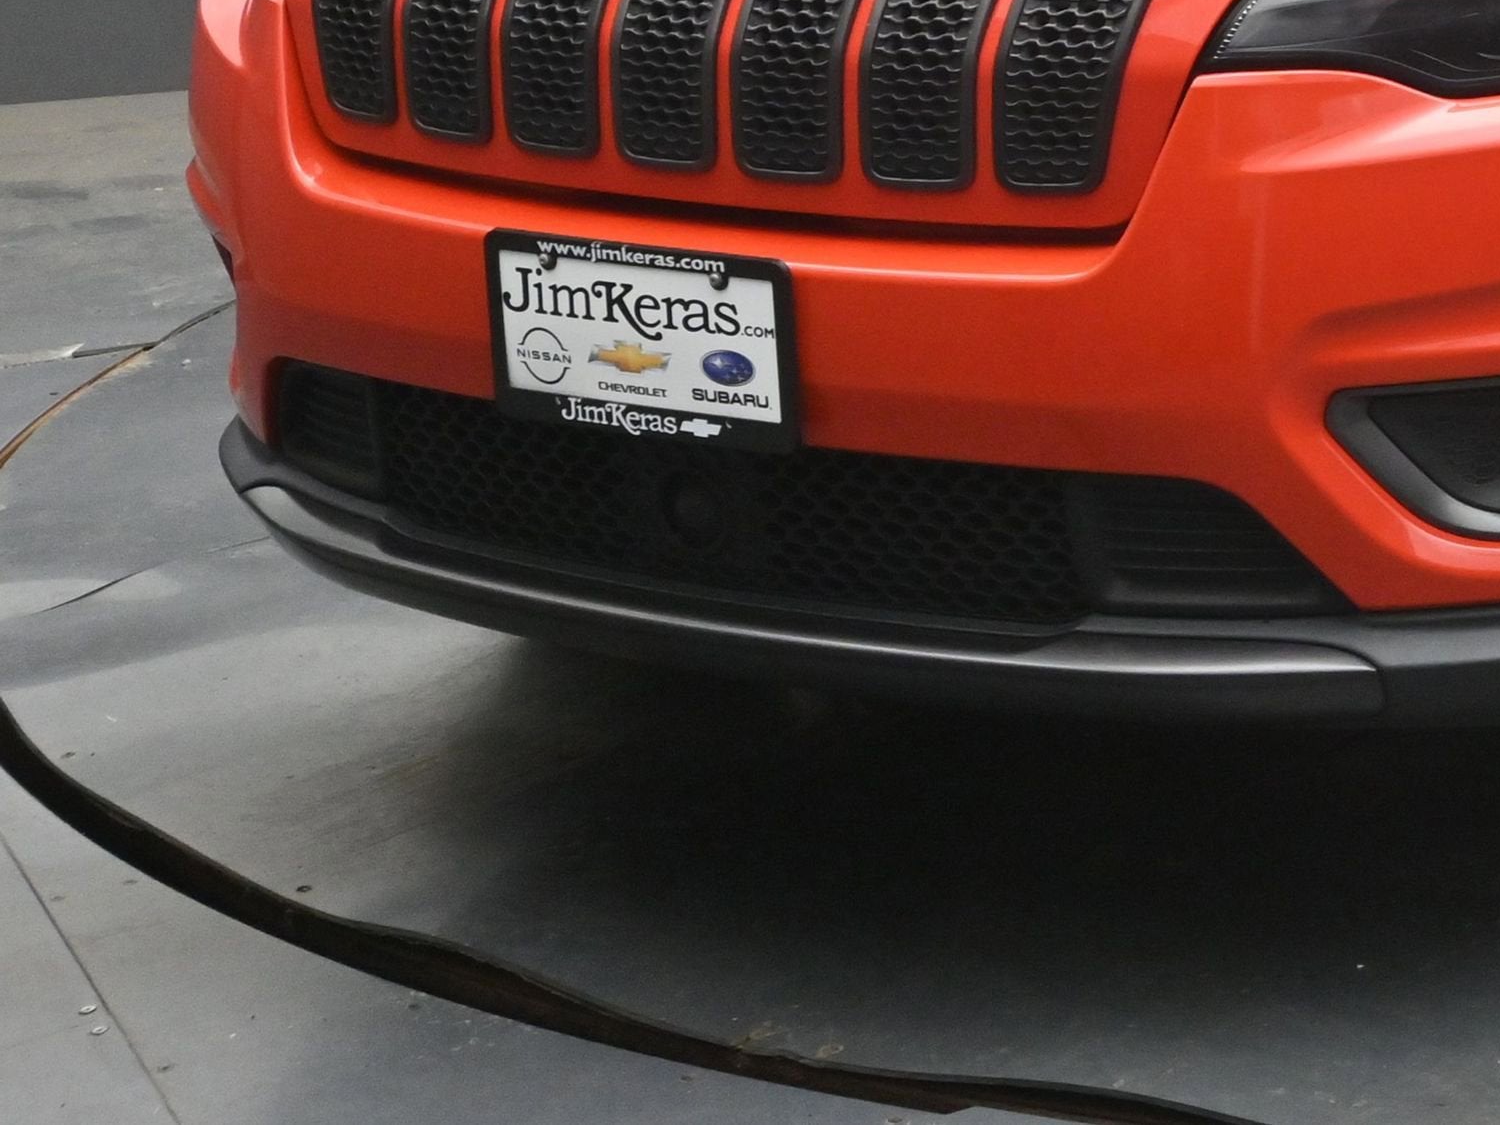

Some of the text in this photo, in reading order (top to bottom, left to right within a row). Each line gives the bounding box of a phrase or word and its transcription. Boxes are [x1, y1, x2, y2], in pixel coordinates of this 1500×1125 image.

[537, 240, 725, 273] www.jimkeras.com
[516, 347, 572, 365] NISSAN
[598, 381, 668, 398] CHEVROLET
[692, 388, 769, 409] SUBARU
